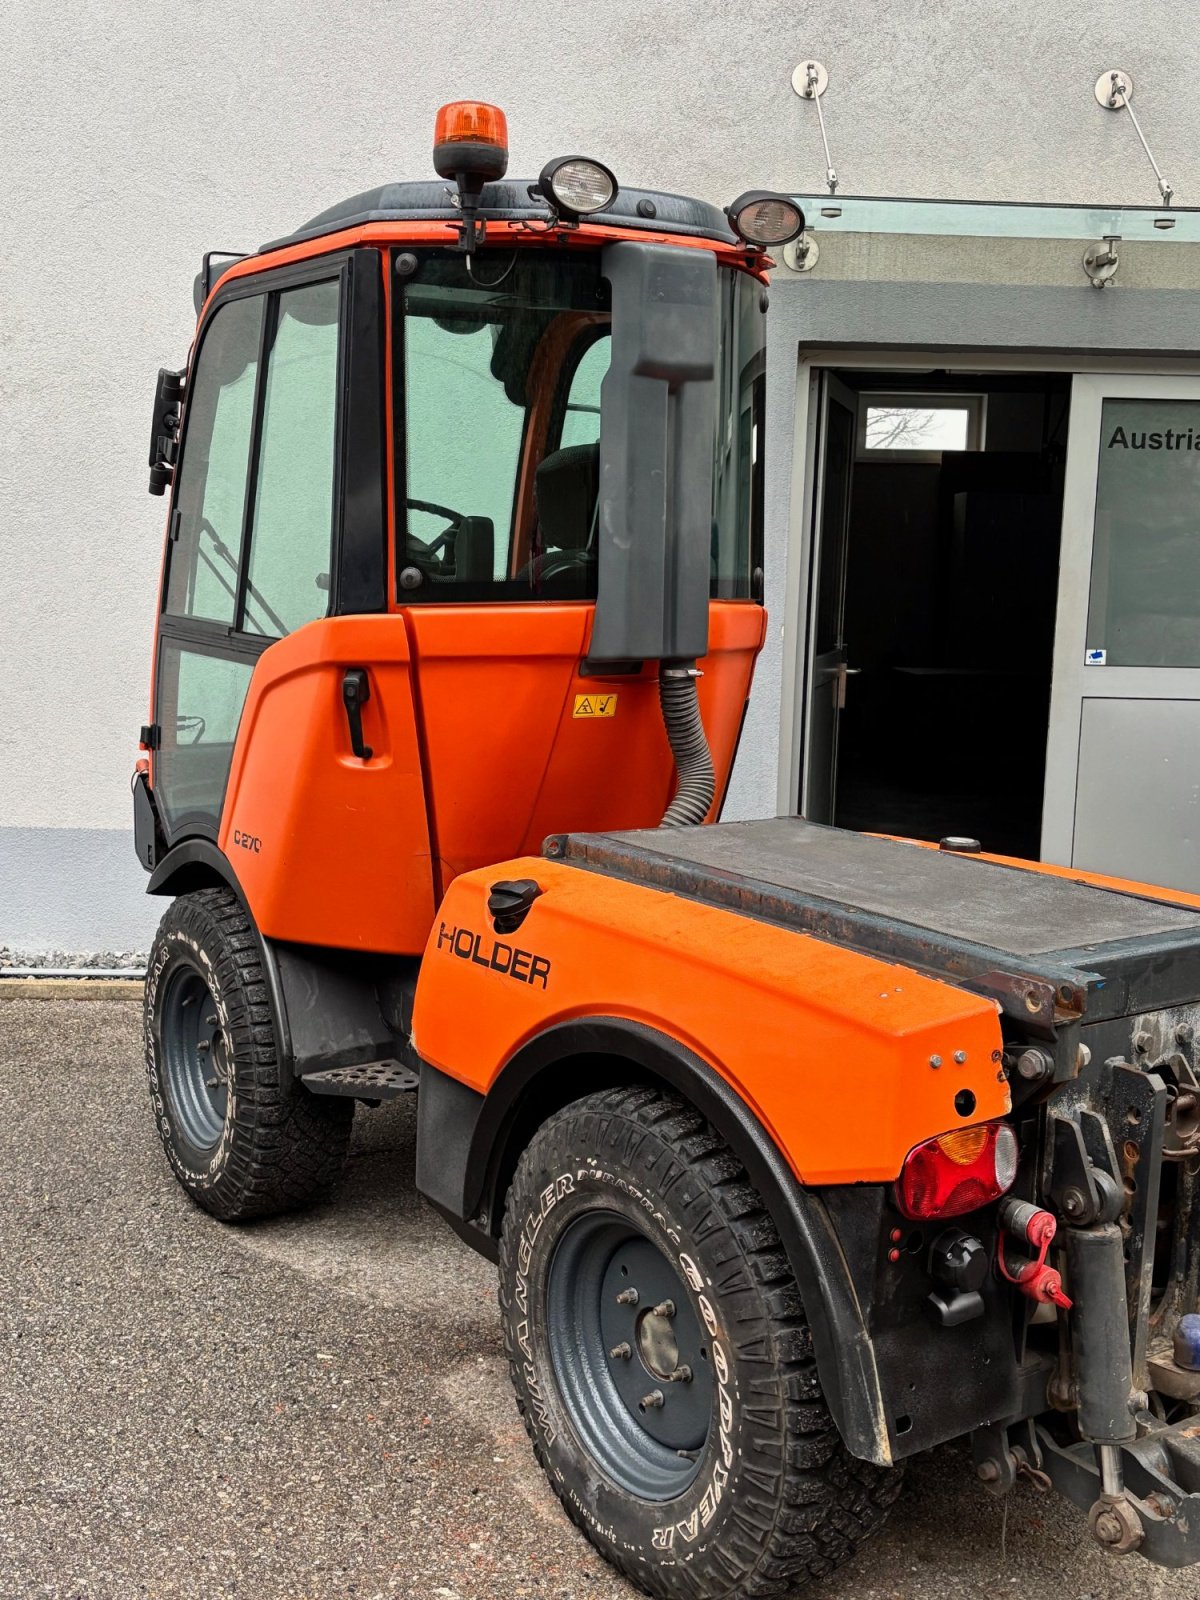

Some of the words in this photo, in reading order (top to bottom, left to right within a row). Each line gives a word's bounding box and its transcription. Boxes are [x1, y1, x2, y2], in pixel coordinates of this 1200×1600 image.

[437, 921, 552, 990] HOLDER
[514, 1172, 576, 1448] WRANGLER
[651, 1252, 734, 1551] GOODYEAR
